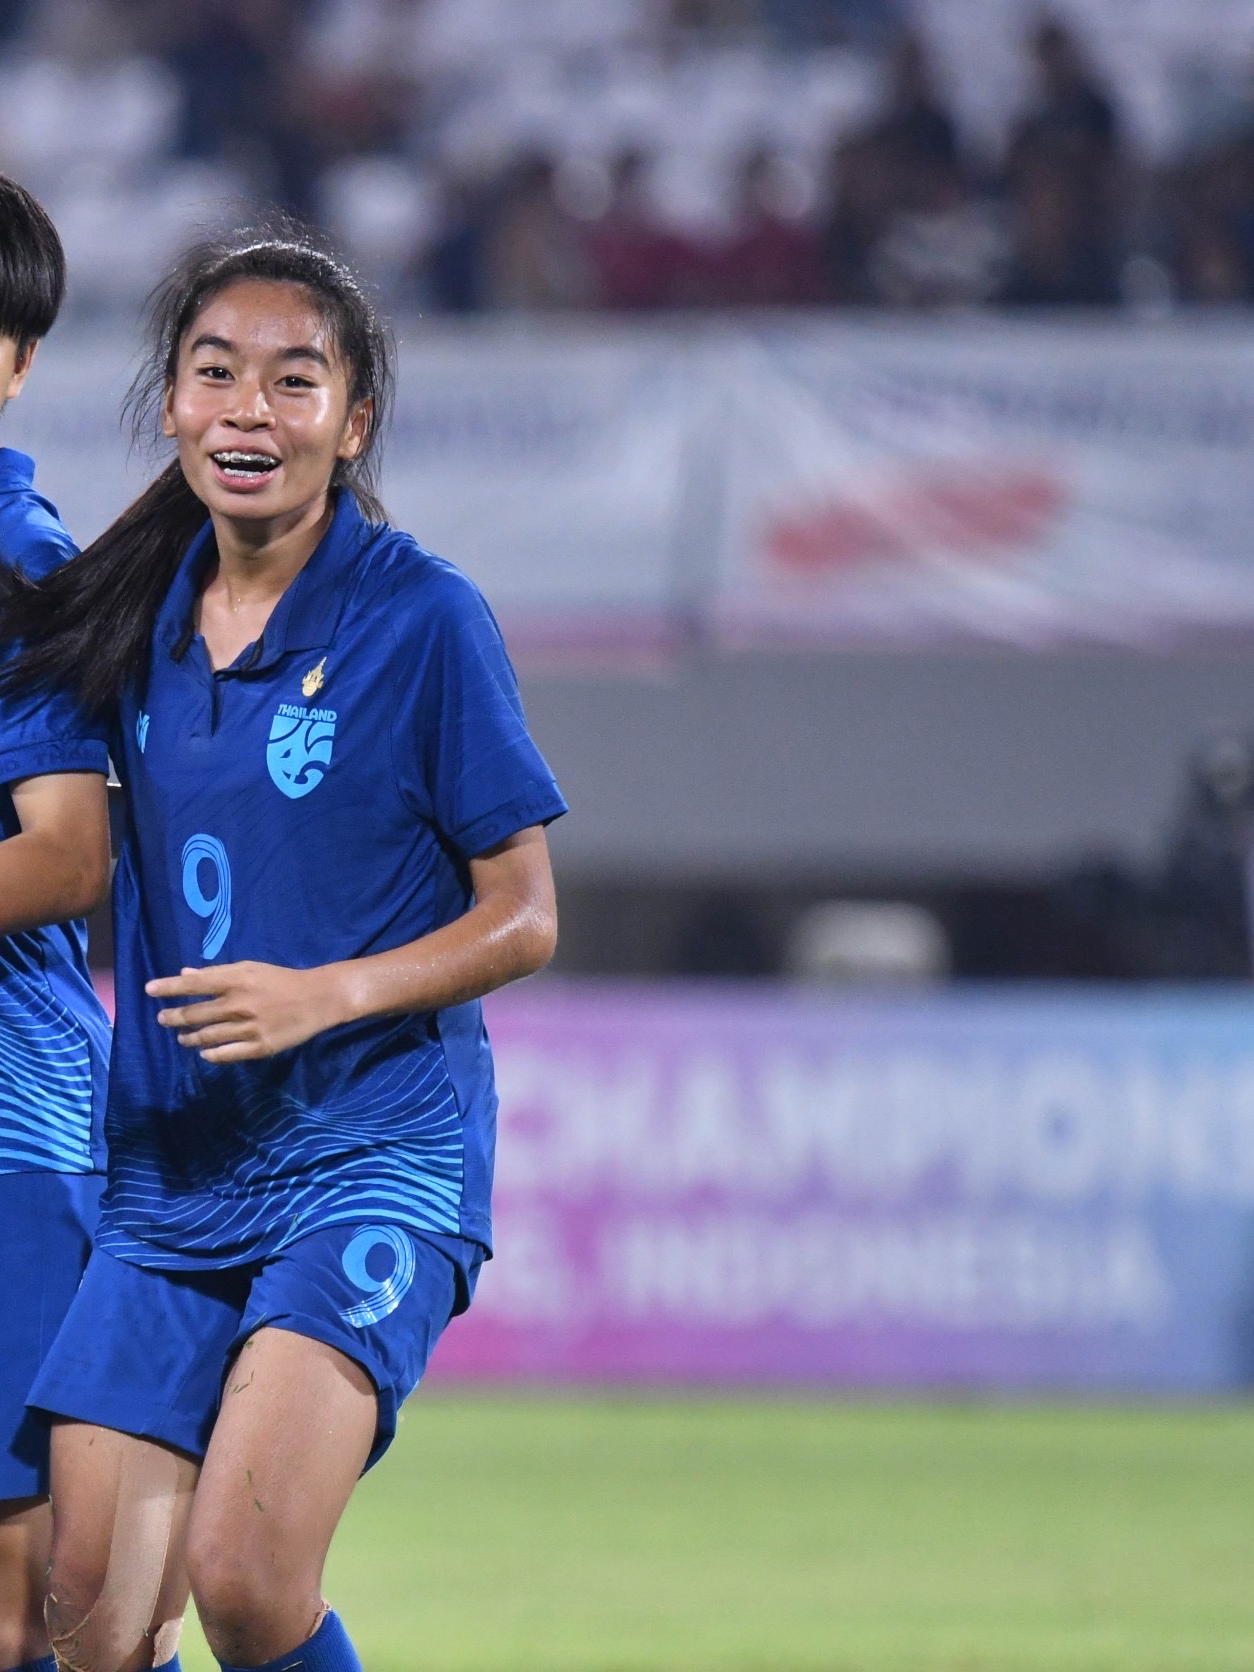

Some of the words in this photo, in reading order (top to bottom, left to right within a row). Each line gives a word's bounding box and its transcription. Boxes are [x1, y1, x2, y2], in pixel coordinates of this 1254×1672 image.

[277, 703, 338, 722] THAILAND
[181, 833, 232, 960] 9
[339, 1223, 416, 1328] 9
